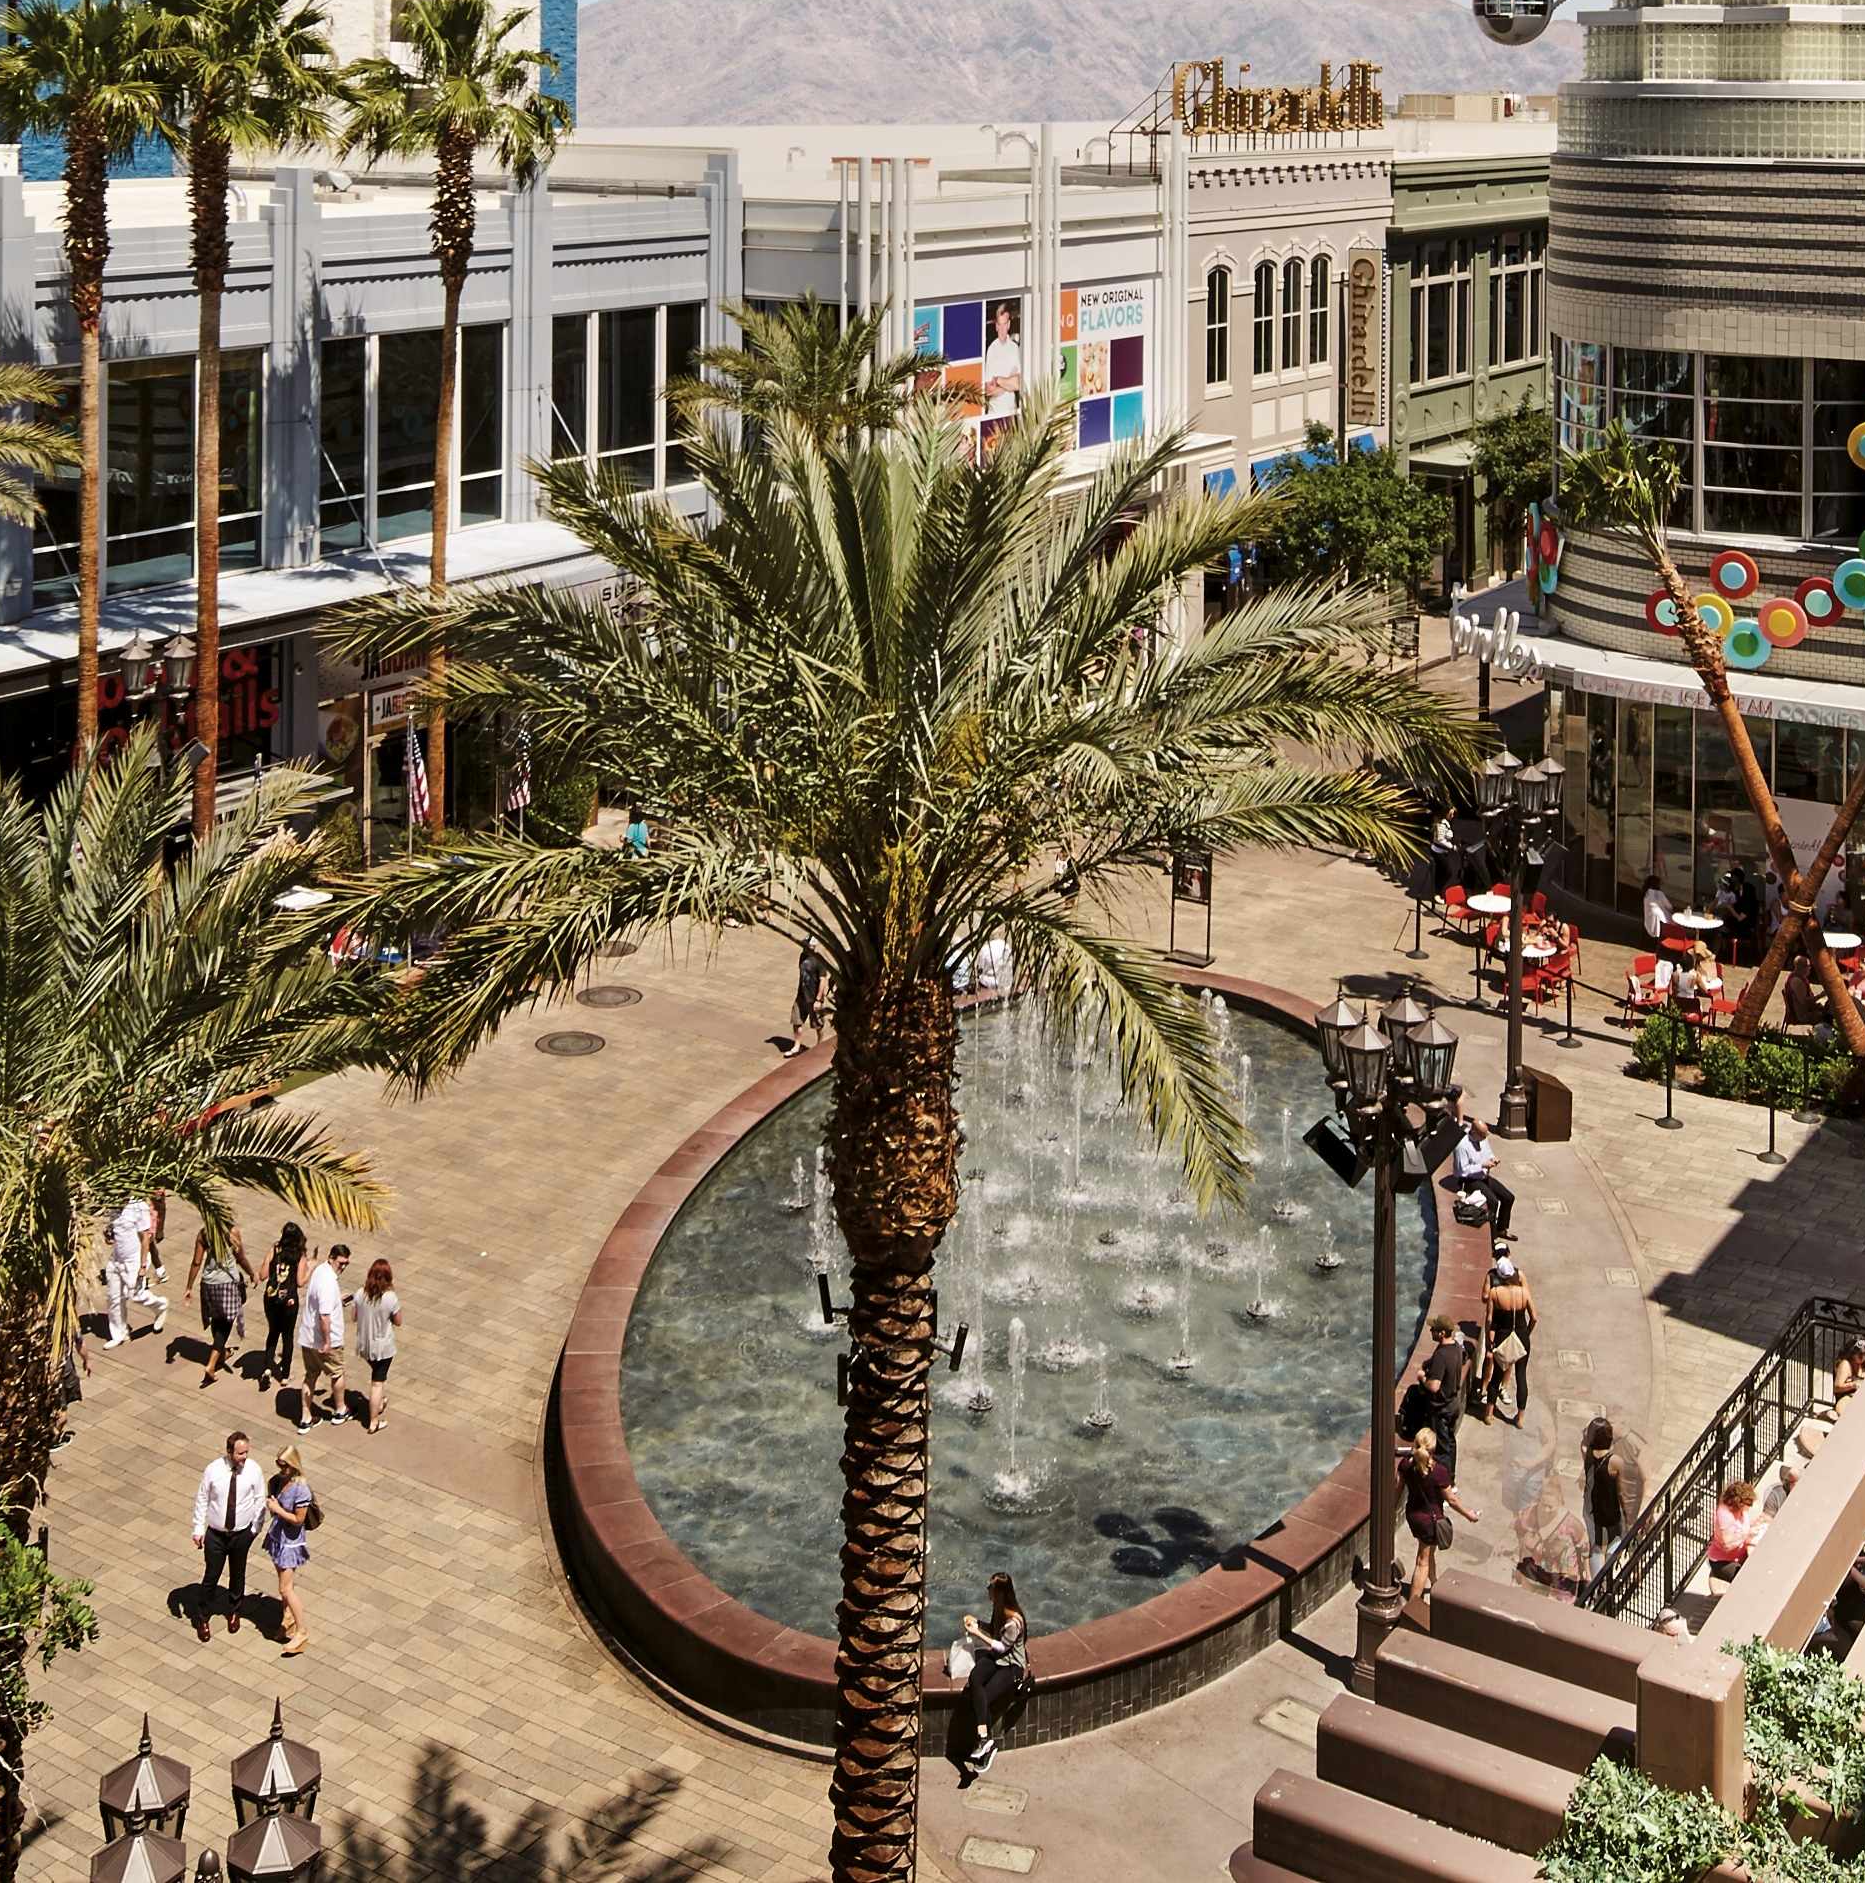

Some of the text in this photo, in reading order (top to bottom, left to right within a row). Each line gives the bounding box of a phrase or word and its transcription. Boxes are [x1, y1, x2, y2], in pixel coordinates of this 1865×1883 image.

[1173, 56, 1383, 136] Ghirardelli
[1080, 288, 1144, 308] NEW ORIGINAL
[1080, 303, 1143, 333] FLAVORS
[1351, 258, 1376, 417] Ghirardelli
[1778, 703, 1863, 730] COOKIES
